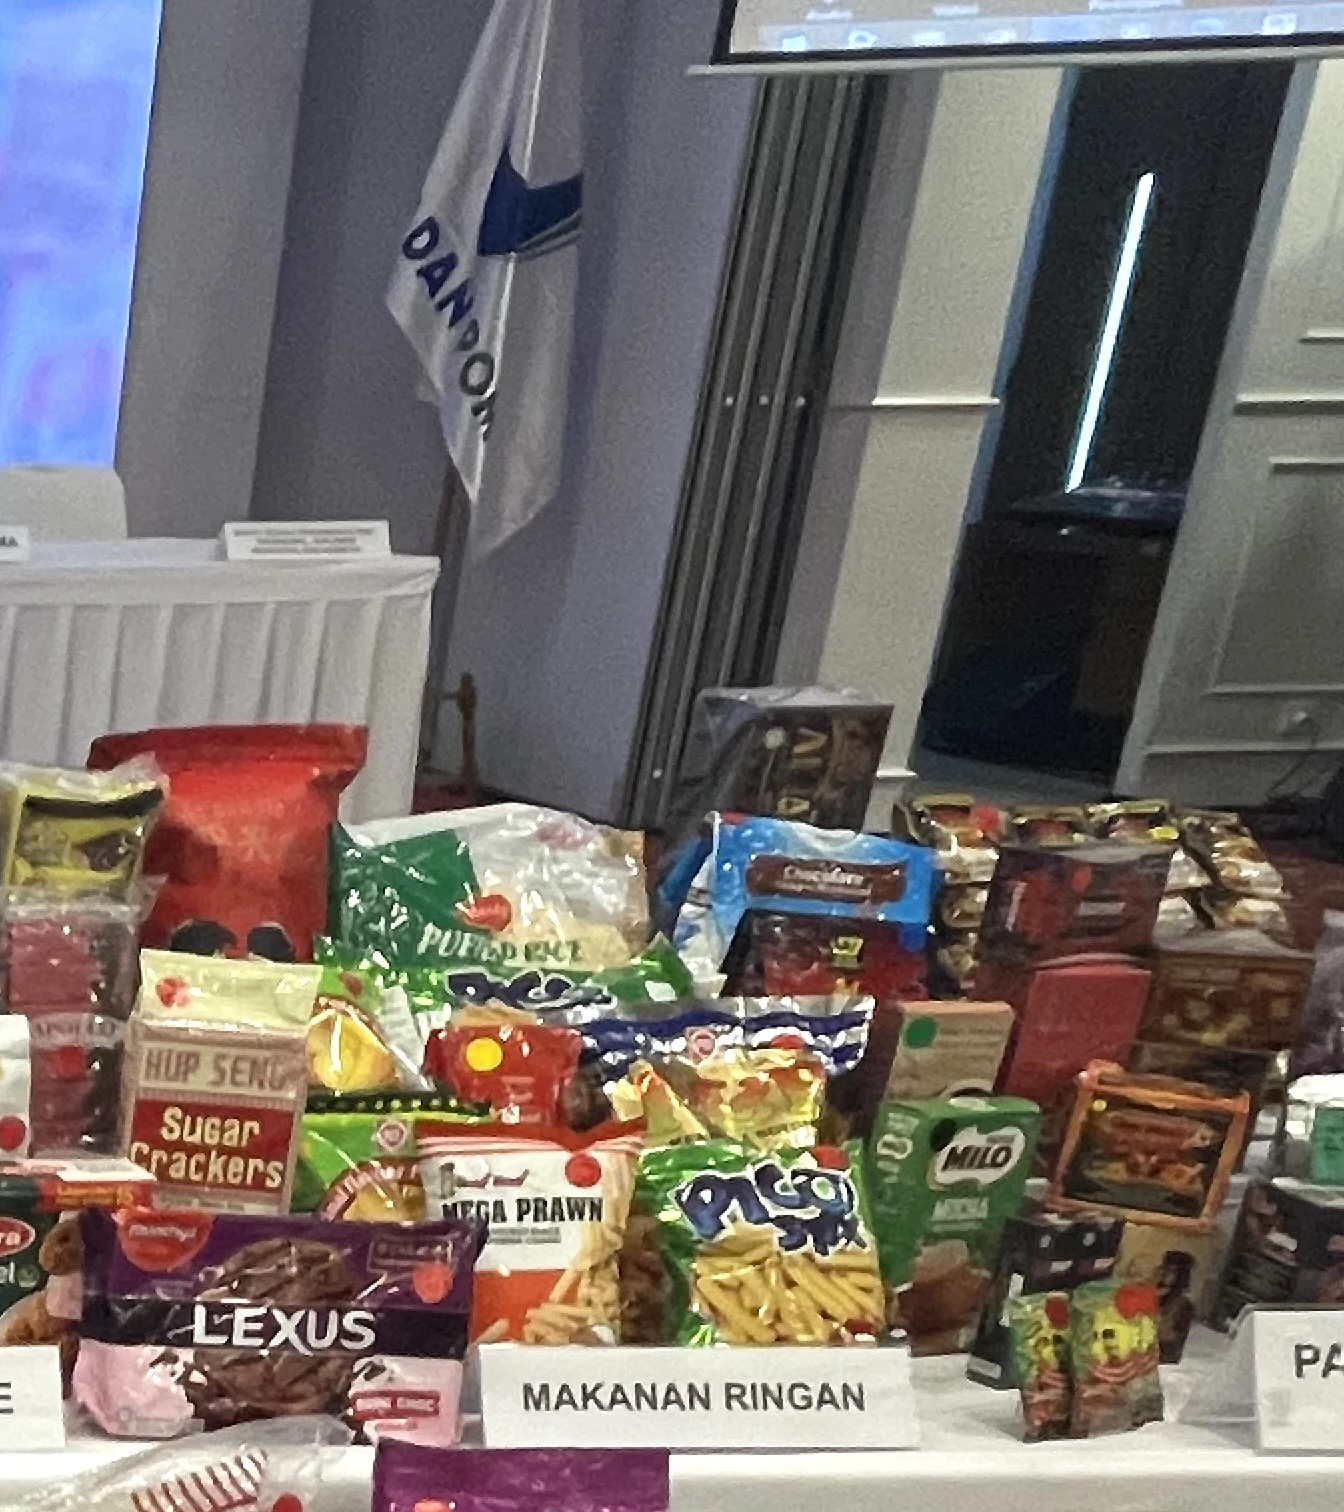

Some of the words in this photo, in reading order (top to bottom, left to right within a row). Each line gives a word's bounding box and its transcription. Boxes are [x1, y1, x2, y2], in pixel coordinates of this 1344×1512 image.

[160, 1106, 262, 1148] Sugar
[130, 1142, 285, 1190] Crackers
[942, 1141, 1013, 1172] MILO
[515, 1196, 605, 1224] PRAWN
[192, 1304, 378, 1357] LEXUS
[522, 1381, 713, 1413] MAKANAN
[723, 1380, 867, 1413] RINGAN
